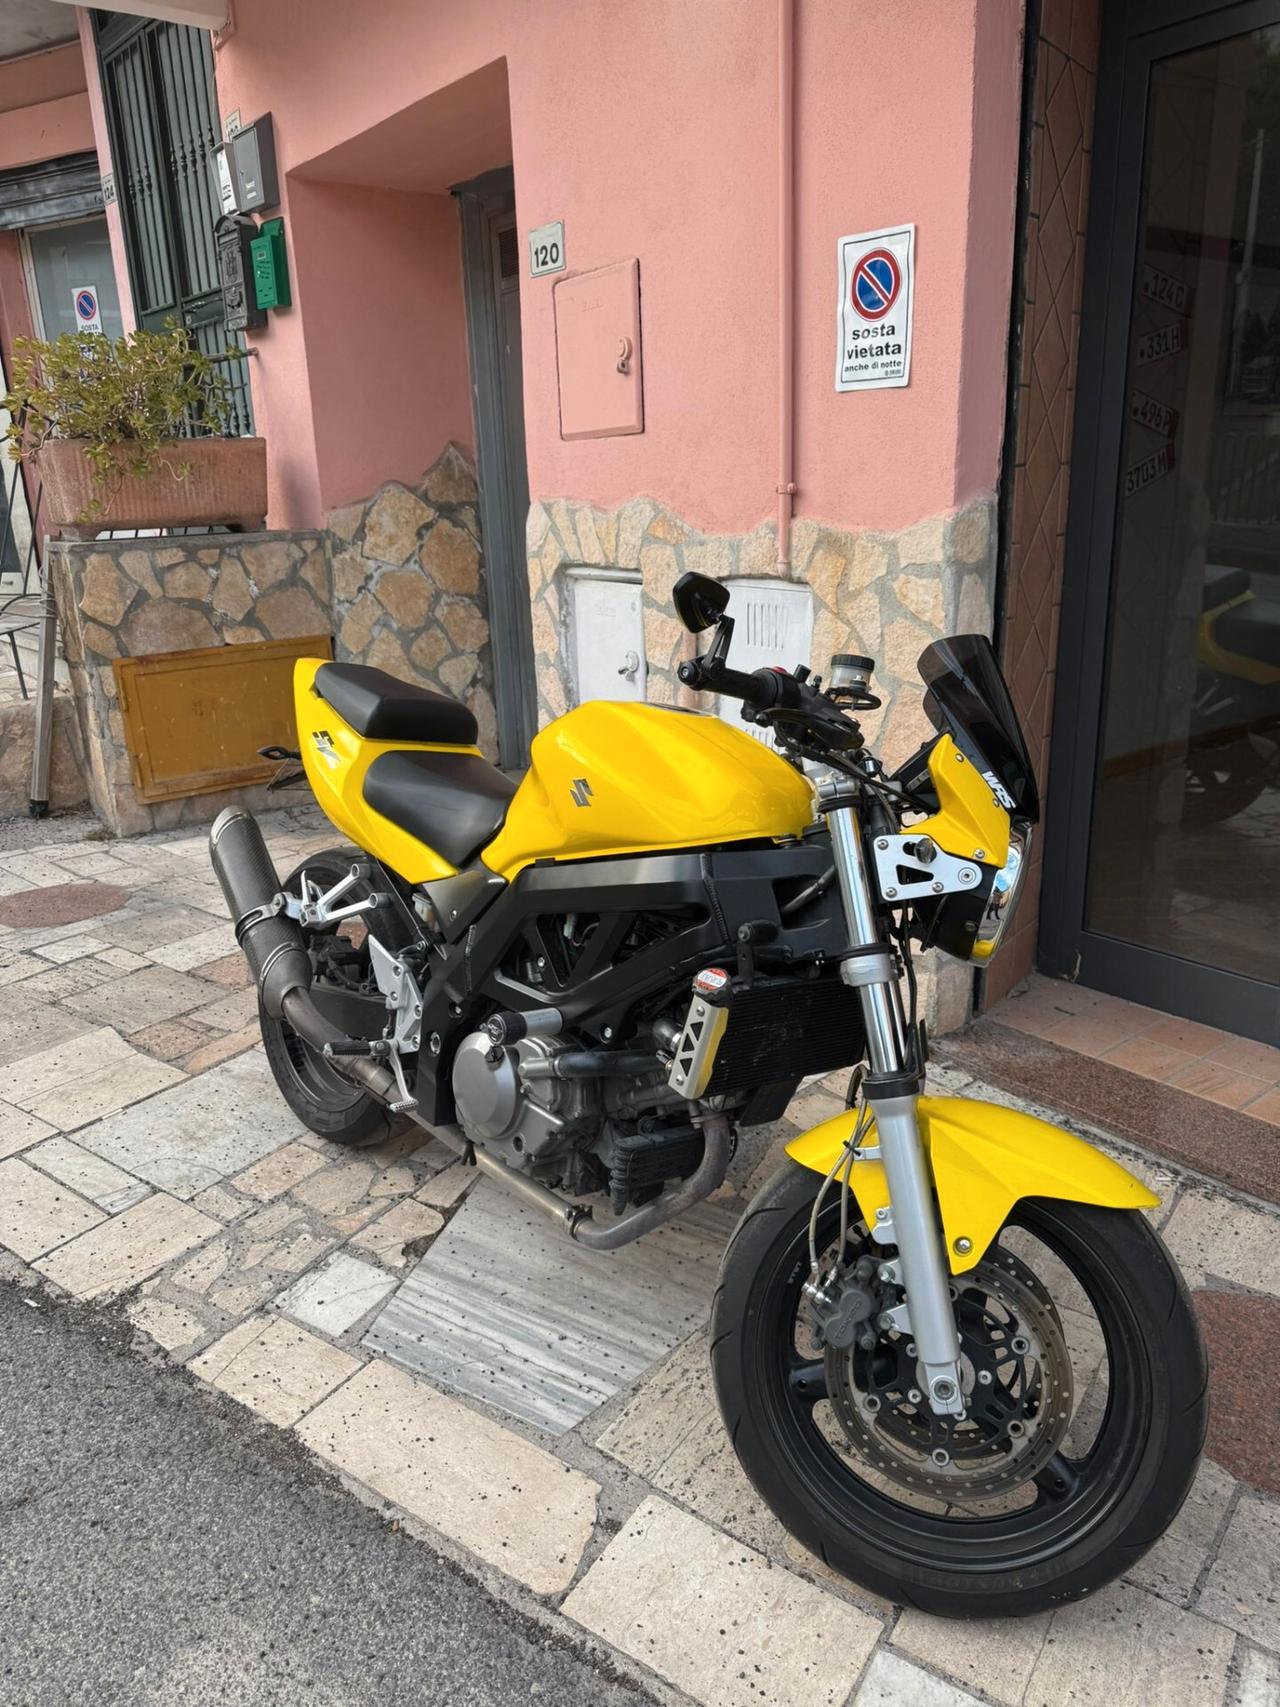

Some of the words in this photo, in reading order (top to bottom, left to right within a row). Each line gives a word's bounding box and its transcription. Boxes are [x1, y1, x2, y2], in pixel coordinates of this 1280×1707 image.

[534, 242, 560, 268] 120
[851, 322, 896, 341] sosta
[846, 341, 902, 360] vietata
[844, 363, 869, 372] anche
[871, 361, 879, 370] di
[880, 360, 902, 368] notte
